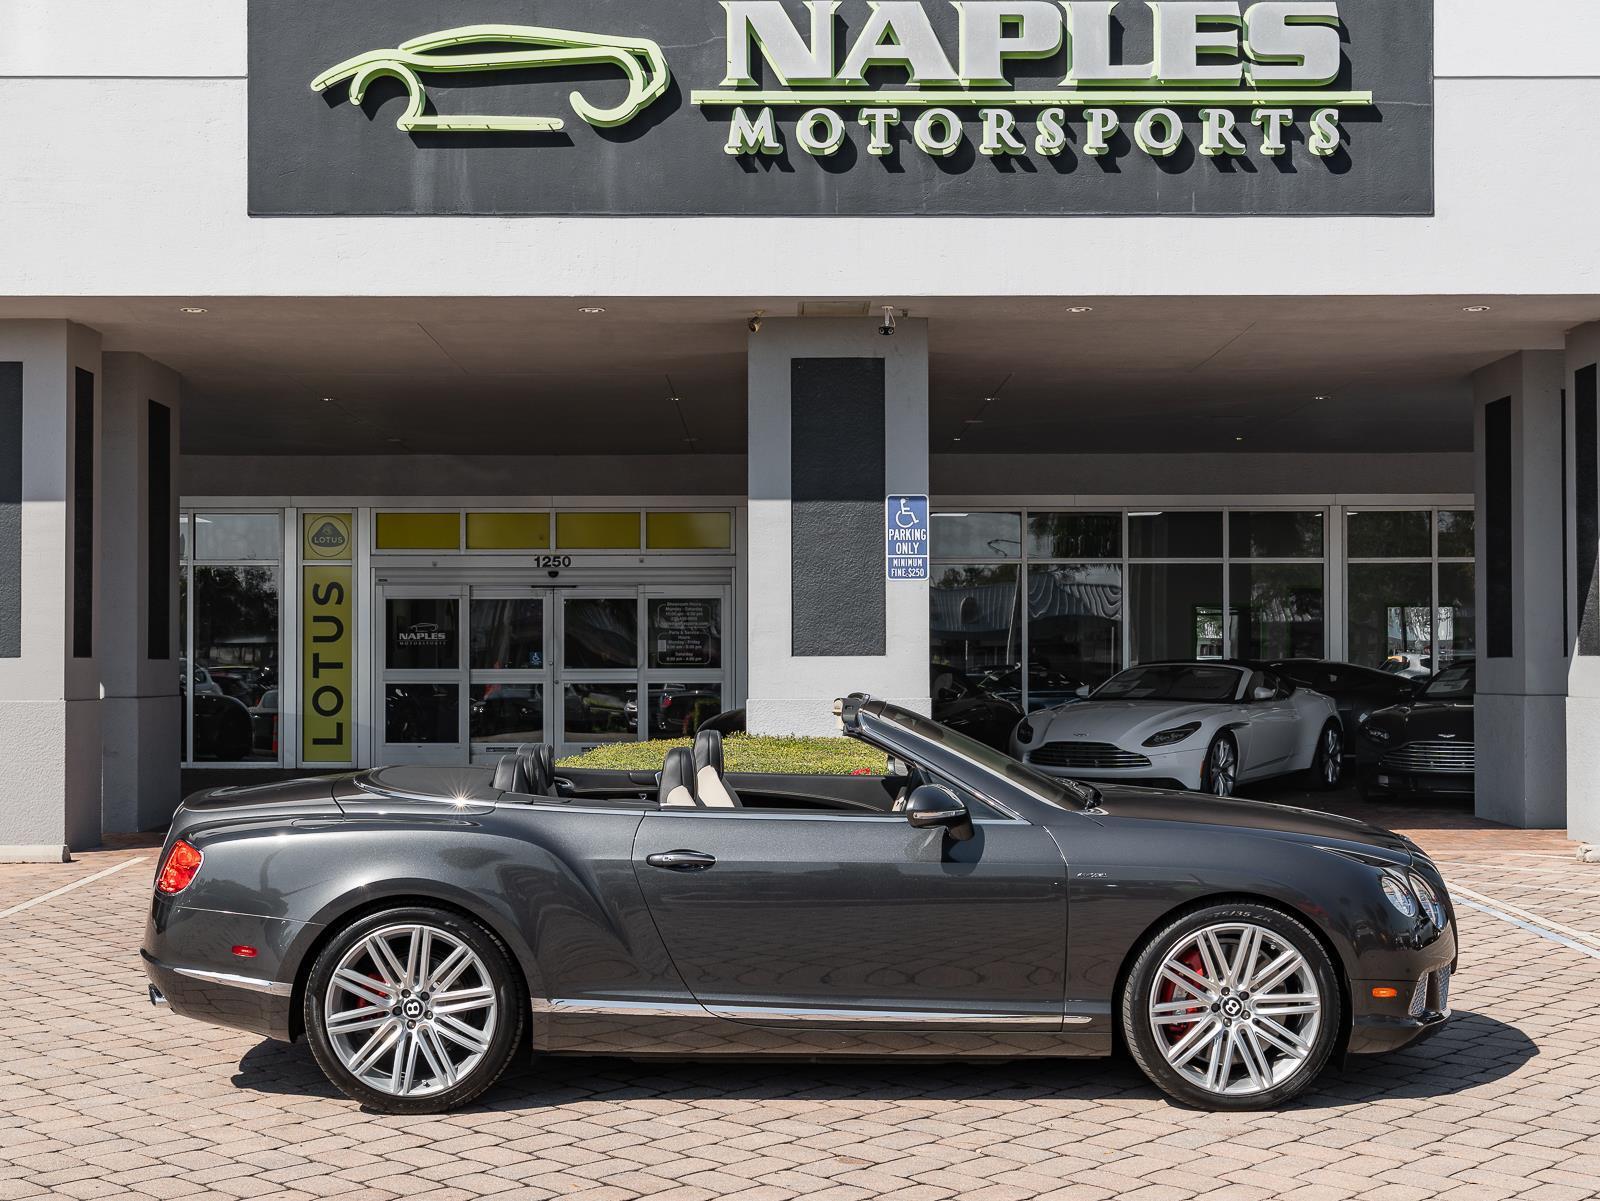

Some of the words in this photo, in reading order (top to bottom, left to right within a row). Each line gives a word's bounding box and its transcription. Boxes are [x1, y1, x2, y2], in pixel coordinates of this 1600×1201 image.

[719, 0, 1340, 86] NAPLES
[724, 107, 1341, 156] MOTORSPORTS
[888, 529, 926, 540] PARKING
[896, 542, 920, 554] ONLY
[533, 555, 572, 568] 1250
[893, 558, 922, 567] MINIMUM
[312, 581, 344, 746] LOTUS
